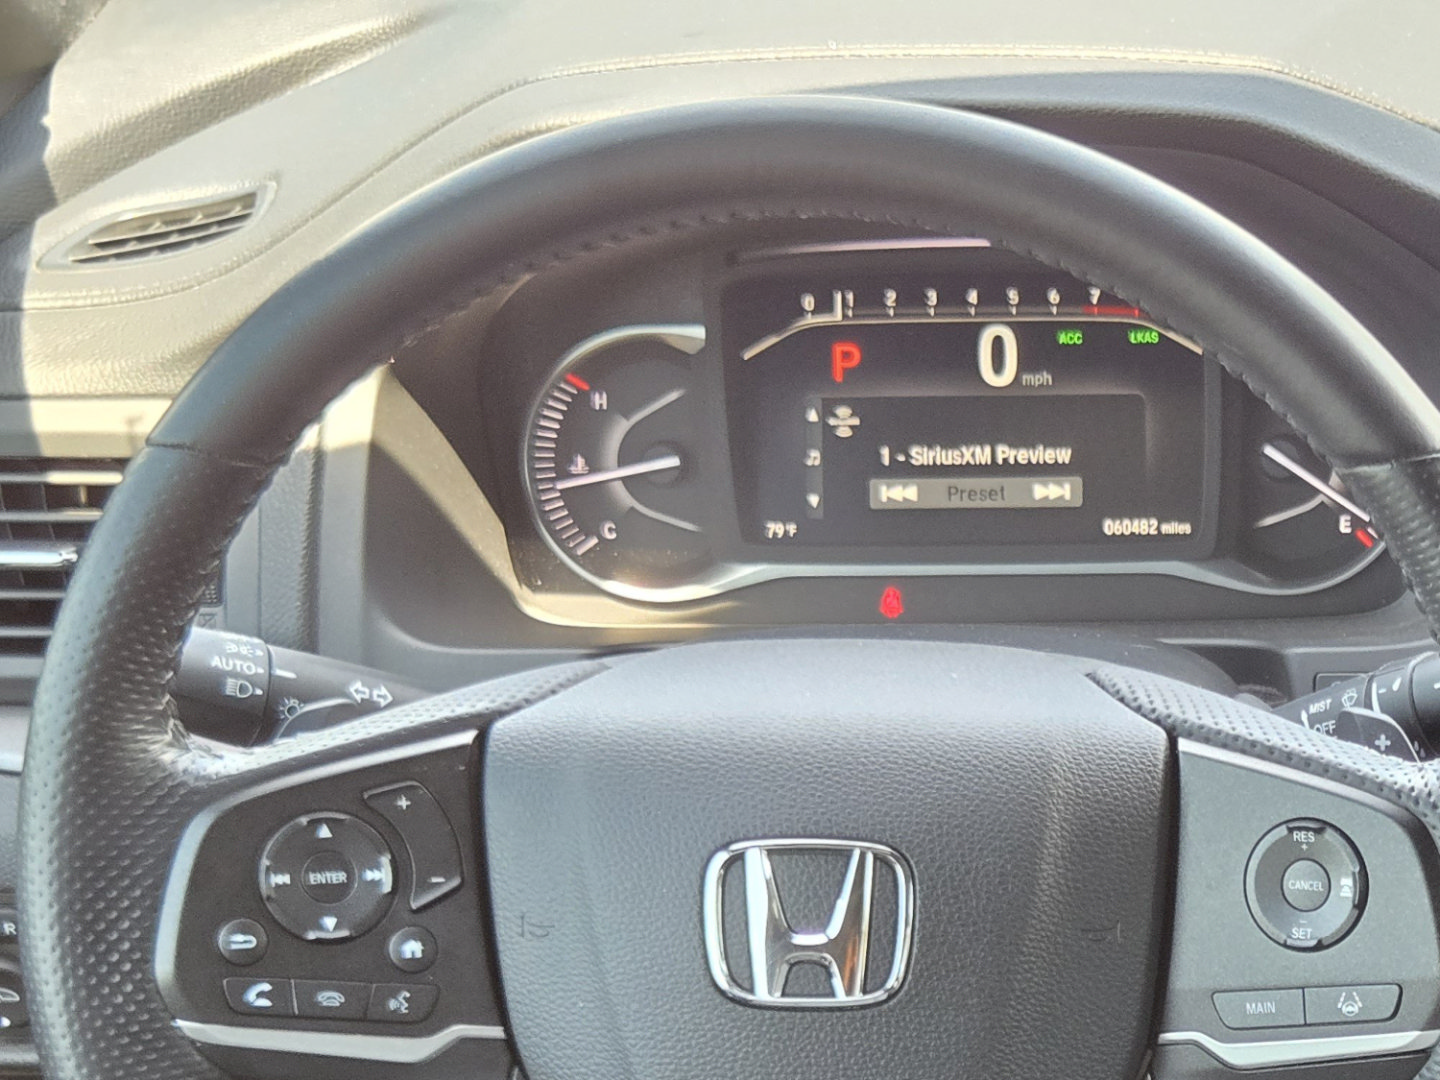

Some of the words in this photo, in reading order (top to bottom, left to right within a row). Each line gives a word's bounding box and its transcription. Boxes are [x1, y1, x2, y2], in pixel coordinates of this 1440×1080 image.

[801, 293, 815, 312] 0
[883, 288, 897, 307] 2
[924, 288, 938, 307] 3
[966, 287, 979, 305] 4
[1007, 286, 1020, 305] 5
[1047, 287, 1061, 304] 6
[1087, 286, 1101, 304] 7
[1057, 330, 1083, 344] ACC
[1128, 330, 1159, 344] LKAS
[831, 342, 861, 382] P
[978, 323, 1018, 388] 0
[1022, 371, 1053, 386] mph
[591, 390, 608, 410] H
[879, 445, 890, 466] 1
[909, 444, 992, 466] SiriusXM
[995, 443, 1073, 465] Preview
[947, 485, 1006, 503] Preset
[601, 521, 618, 540] C
[1103, 518, 1158, 536] 060482
[1159, 521, 1192, 535] miles
[1339, 514, 1352, 534] E
[210, 656, 257, 675] AUTO
[1309, 698, 1332, 715] MIST
[1293, 831, 1316, 844] RES
[309, 871, 348, 884] ENTER
[1287, 879, 1325, 893] CANCEL
[1291, 927, 1313, 940] SET
[1245, 1001, 1277, 1015] MAIN
